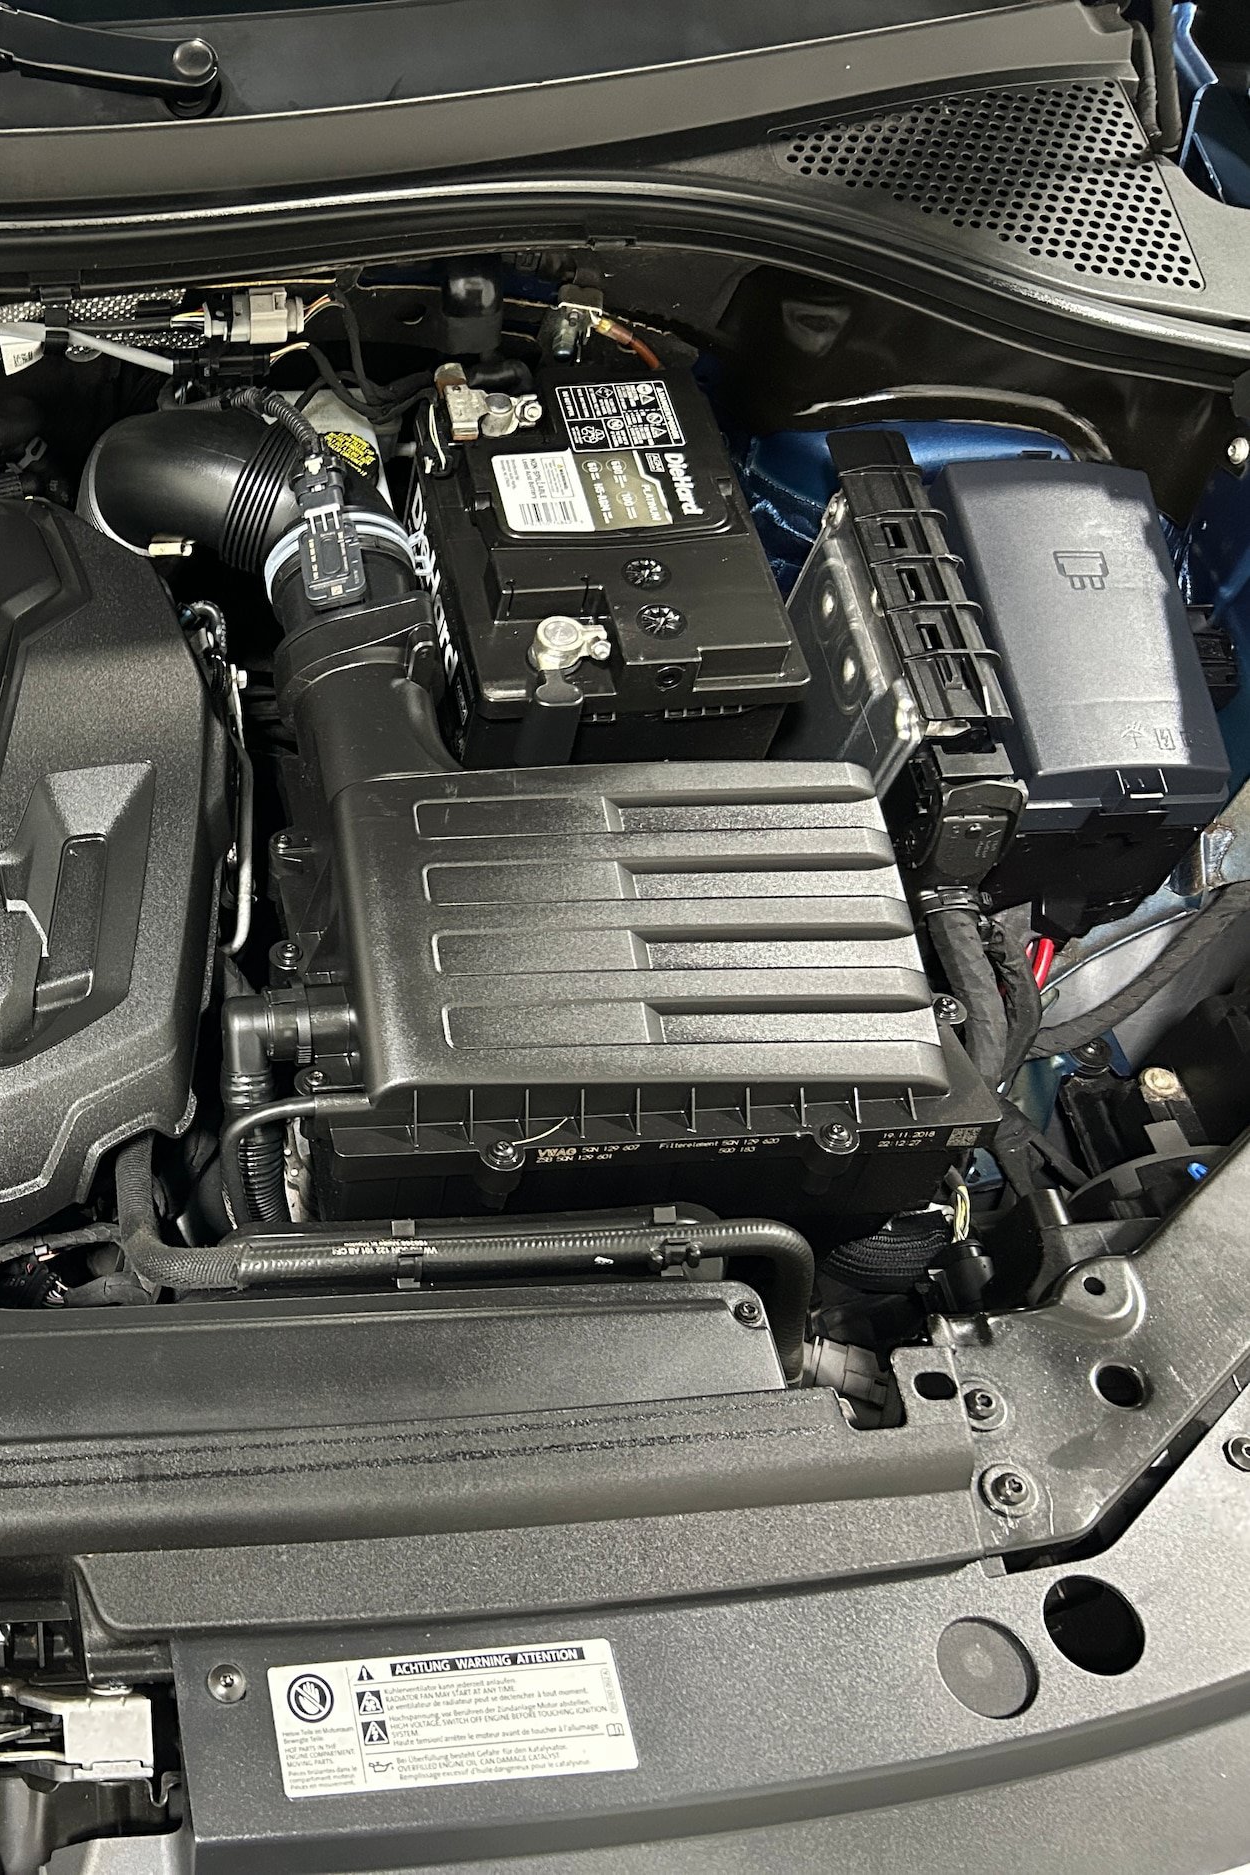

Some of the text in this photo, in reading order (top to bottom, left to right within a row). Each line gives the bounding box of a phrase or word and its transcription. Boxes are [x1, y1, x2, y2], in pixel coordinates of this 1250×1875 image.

[664, 452, 704, 516] DieHard
[641, 484, 661, 522] PLATINUM
[882, 1130, 936, 1140] 19.11.2018
[659, 1140, 719, 1150] Filterelement
[743, 1138, 760, 1146] 129
[877, 1139, 922, 1148] 22:12:27
[537, 1148, 577, 1158] VWAG
[393, 1648, 578, 1675] ACHTUNG WARNING ATTENTION
[385, 1694, 418, 1702] RADIATOR
[442, 1717, 468, 1725] SWITCH
[484, 1713, 509, 1722] ENGINE
[511, 1711, 536, 1719] BEFORE
[538, 1707, 574, 1717] TOUCHING
[575, 1704, 607, 1713] IGNITION
[397, 1763, 437, 1773] OVERFILLED
[438, 1760, 464, 1769] ENGINE
[479, 1757, 495, 1765] CAN
[496, 1754, 526, 1763] DAMAGE
